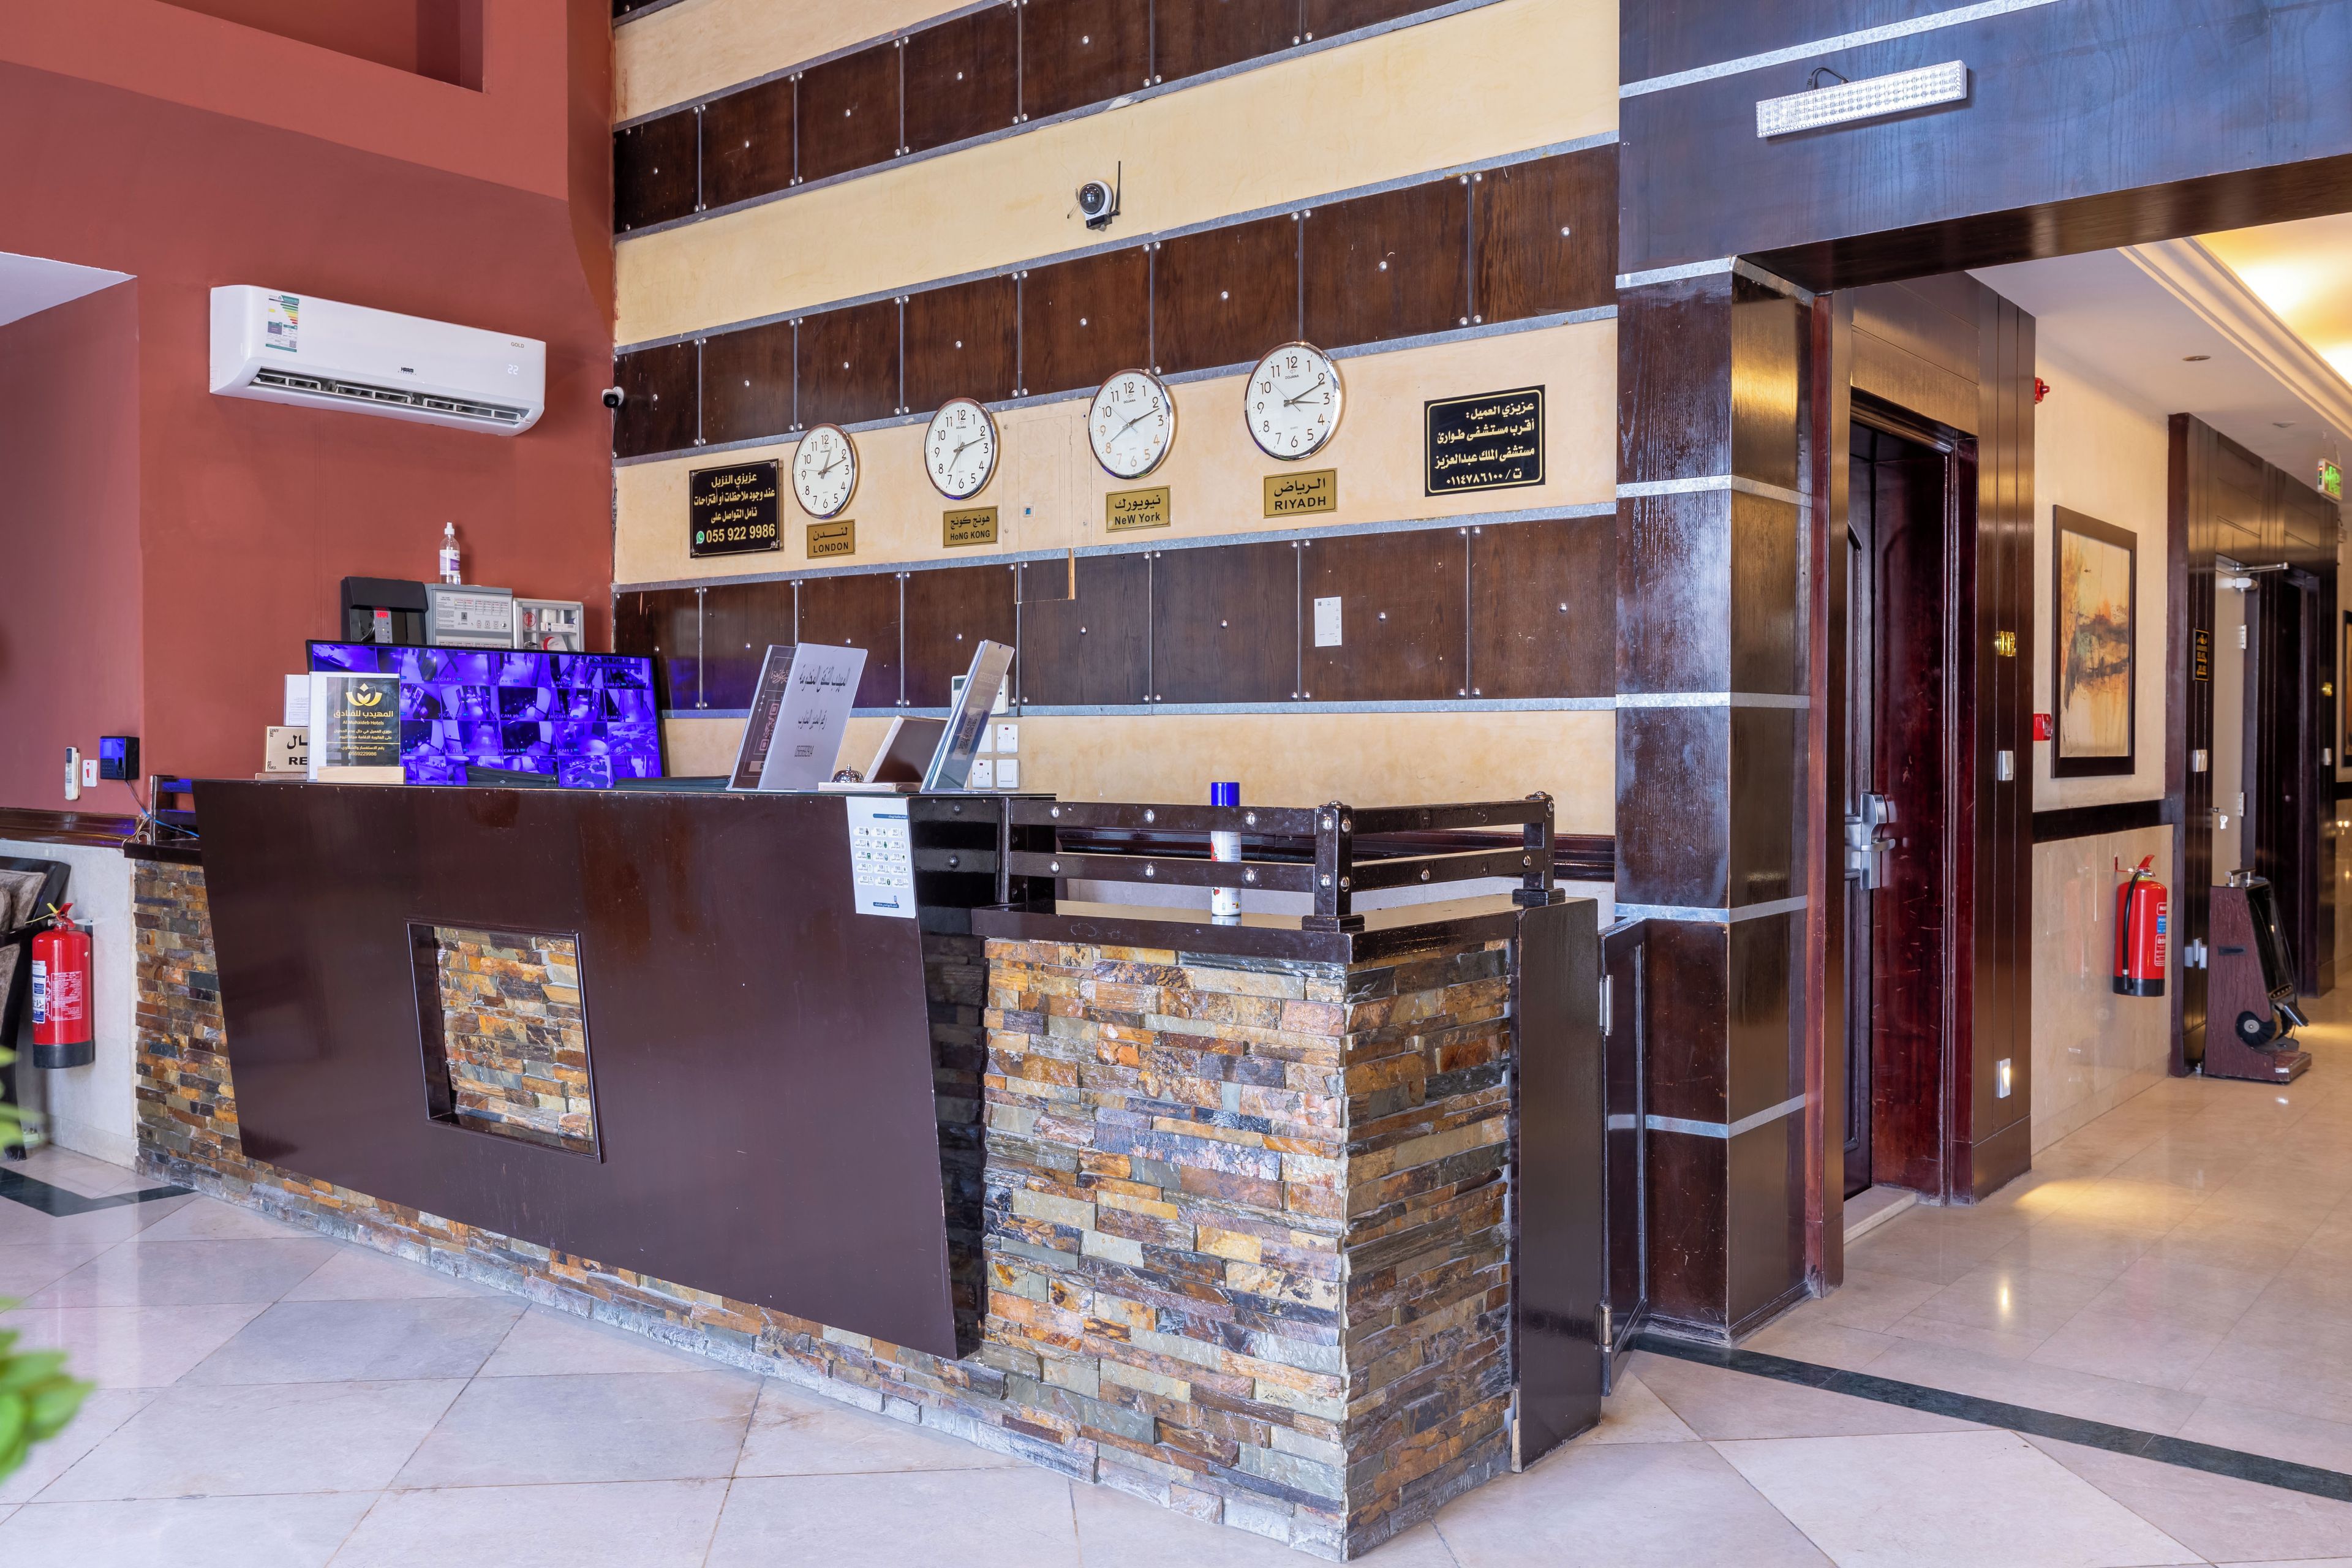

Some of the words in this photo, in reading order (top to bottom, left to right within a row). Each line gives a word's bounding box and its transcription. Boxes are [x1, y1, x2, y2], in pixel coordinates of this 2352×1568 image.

[1286, 356, 1297, 369] 12
[1307, 360, 1311, 372] 1
[508, 364, 519, 375] 22
[1271, 365, 1280, 377] 11
[1317, 372, 1324, 385] 2
[1124, 382, 1134, 393] 12
[1142, 385, 1146, 396] 1
[1261, 382, 1272, 394] 10
[1111, 391, 1119, 402] 11
[1153, 396, 1159, 408] 2
[1323, 393, 1330, 405] 3
[1102, 406, 1111, 418] 10
[1257, 402, 1264, 414] 9
[1502, 402, 1534, 417] عزيزي
[957, 410, 966, 420] 12
[972, 414, 975, 424] 1
[1158, 415, 1164, 426] 3
[1317, 413, 1324, 425] 4
[946, 417, 952, 428] 11
[1264, 420, 1270, 432] 8
[1510, 418, 1534, 435] أقرب
[938, 430, 945, 441] 10
[980, 426, 986, 436] 2
[1100, 425, 1106, 436] 9
[1307, 429, 1313, 440] 5
[1437, 429, 1465, 443] طوارئ
[1467, 424, 1508, 441] مستشفى
[821, 435, 829, 445] 12
[835, 439, 837, 448] 1
[1153, 435, 1159, 446] 4
[1275, 432, 1281, 445] 7
[1291, 435, 1298, 448] 6
[812, 442, 817, 451] 11
[984, 443, 989, 453] 3
[1106, 442, 1111, 454] 8
[842, 449, 846, 459] 2
[935, 447, 940, 458] 9
[1145, 448, 1150, 460] 5
[1479, 449, 1498, 461] الملك
[1499, 445, 1535, 461] مستشفى
[804, 454, 811, 464] 10
[1117, 453, 1122, 465] 7
[1131, 456, 1137, 467] 6
[1435, 453, 1477, 469] عبدالعزيز
[845, 465, 849, 475] 3
[938, 464, 943, 474] 8
[979, 461, 984, 471] 4
[802, 470, 806, 480] 9
[971, 473, 976, 483] 5
[1513, 468, 1522, 479] ت
[711, 475, 733, 488] النزيل
[734, 472, 757, 488] عزيزي
[948, 475, 952, 484] 7
[959, 478, 964, 489] 6
[805, 486, 810, 496] 8
[841, 481, 845, 491] 4
[1274, 478, 1325, 497] الرياض
[725, 491, 748, 502] ملاحظات
[749, 491, 763, 501] وجود
[764, 488, 775, 497] عند
[813, 496, 817, 505] 7
[823, 499, 827, 508] 6
[834, 494, 838, 503] 5
[1115, 495, 1160, 511] نيويورك
[1275, 496, 1326, 510] RIYADH
[711, 512, 722, 524] على
[723, 508, 744, 522] التواصل
[745, 507, 757, 519] نأمل
[951, 516, 971, 530] كونج
[973, 514, 990, 527] هونج
[1115, 514, 1136, 526] NeW
[1139, 512, 1160, 523] York
[706, 529, 725, 543] 055
[727, 526, 746, 541] 922
[749, 524, 775, 540] 9986
[813, 527, 848, 541] لندن
[951, 531, 968, 541] HoNG
[971, 530, 990, 539] KONG
[813, 541, 849, 553] LONDON
